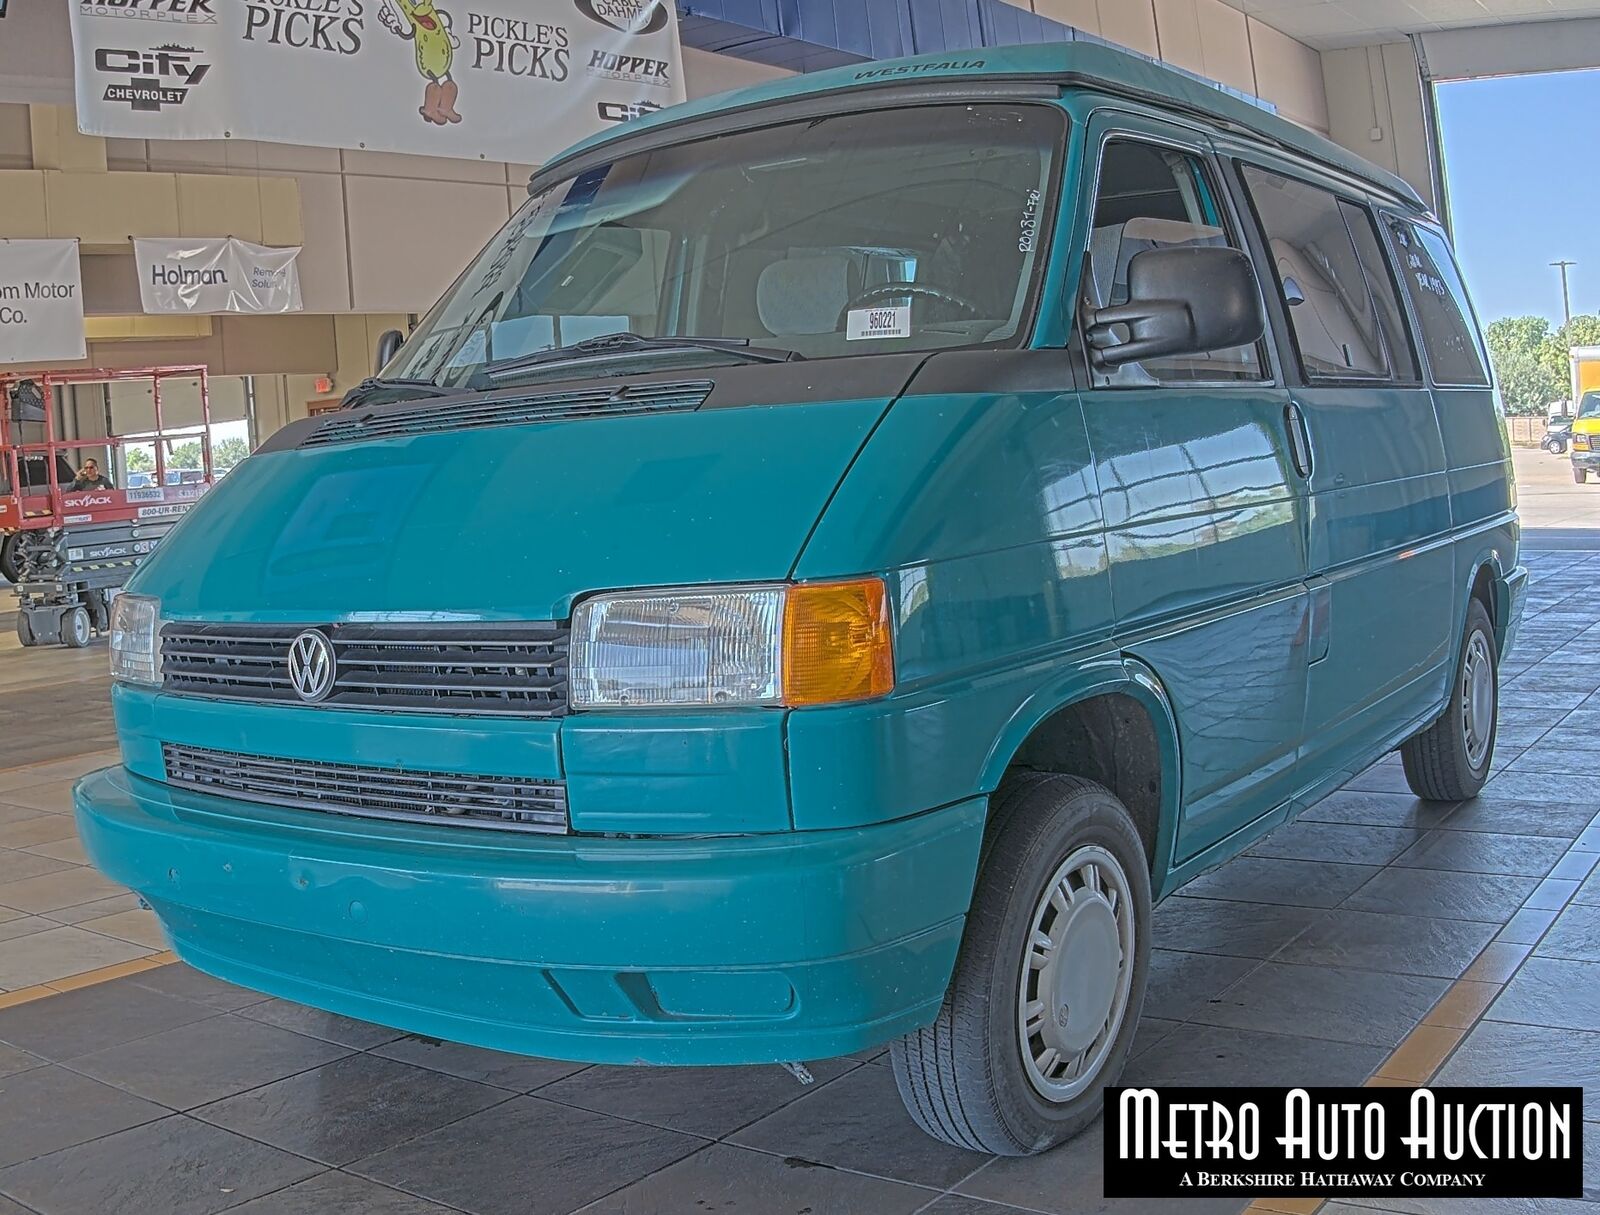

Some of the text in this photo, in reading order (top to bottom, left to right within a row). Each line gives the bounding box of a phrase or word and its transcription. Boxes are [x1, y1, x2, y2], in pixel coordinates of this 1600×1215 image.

[80, 5, 218, 24] MOTORPLEX
[242, 5, 364, 55] PICKS
[467, 12, 569, 47] PICKLE'S
[95, 47, 211, 85] City
[471, 37, 570, 82] PICKS
[588, 50, 670, 79] HOPPER
[854, 60, 986, 80] WESTFALIA
[107, 88, 183, 102] CHEVROLET
[152, 264, 228, 285] Holman
[24, 282, 75, 298] Motor
[0, 306, 27, 324] Co.
[869, 311, 896, 330] 960221
[64, 495, 112, 507] SKYJACK
[89, 547, 126, 557] SKYJACK
[288, 631, 334, 700] VW
